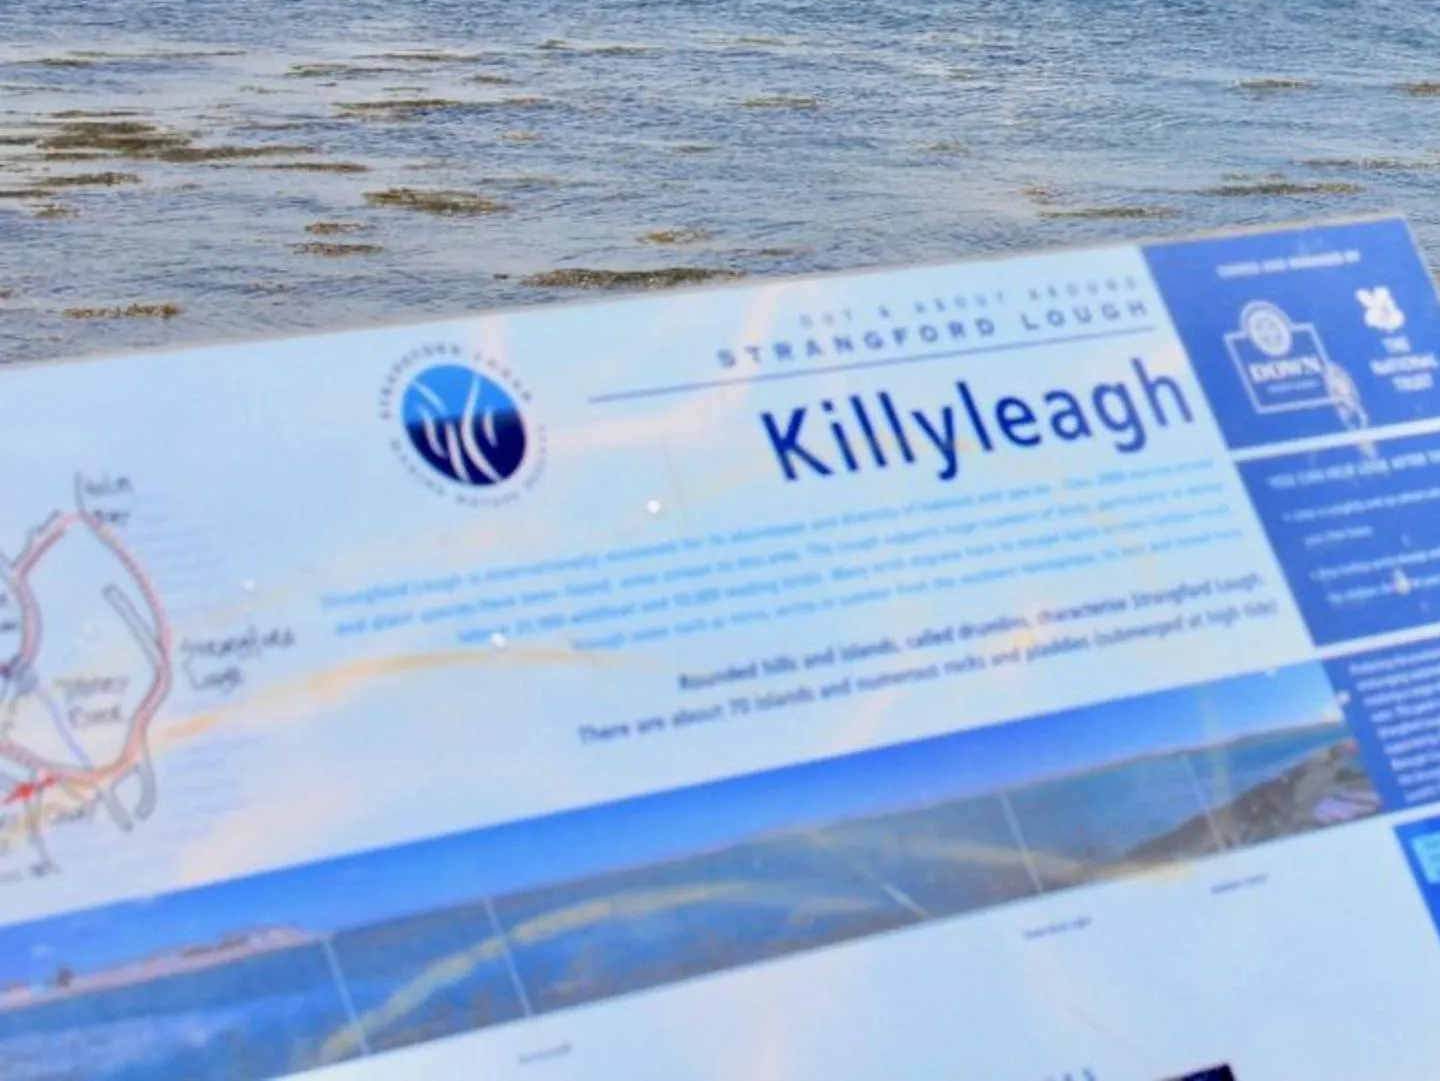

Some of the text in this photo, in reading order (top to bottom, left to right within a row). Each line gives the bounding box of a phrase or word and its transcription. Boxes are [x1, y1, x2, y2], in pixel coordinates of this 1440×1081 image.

[716, 299, 1149, 369] STRANGFORD LOUGH
[758, 357, 1194, 482] Killyleagh
